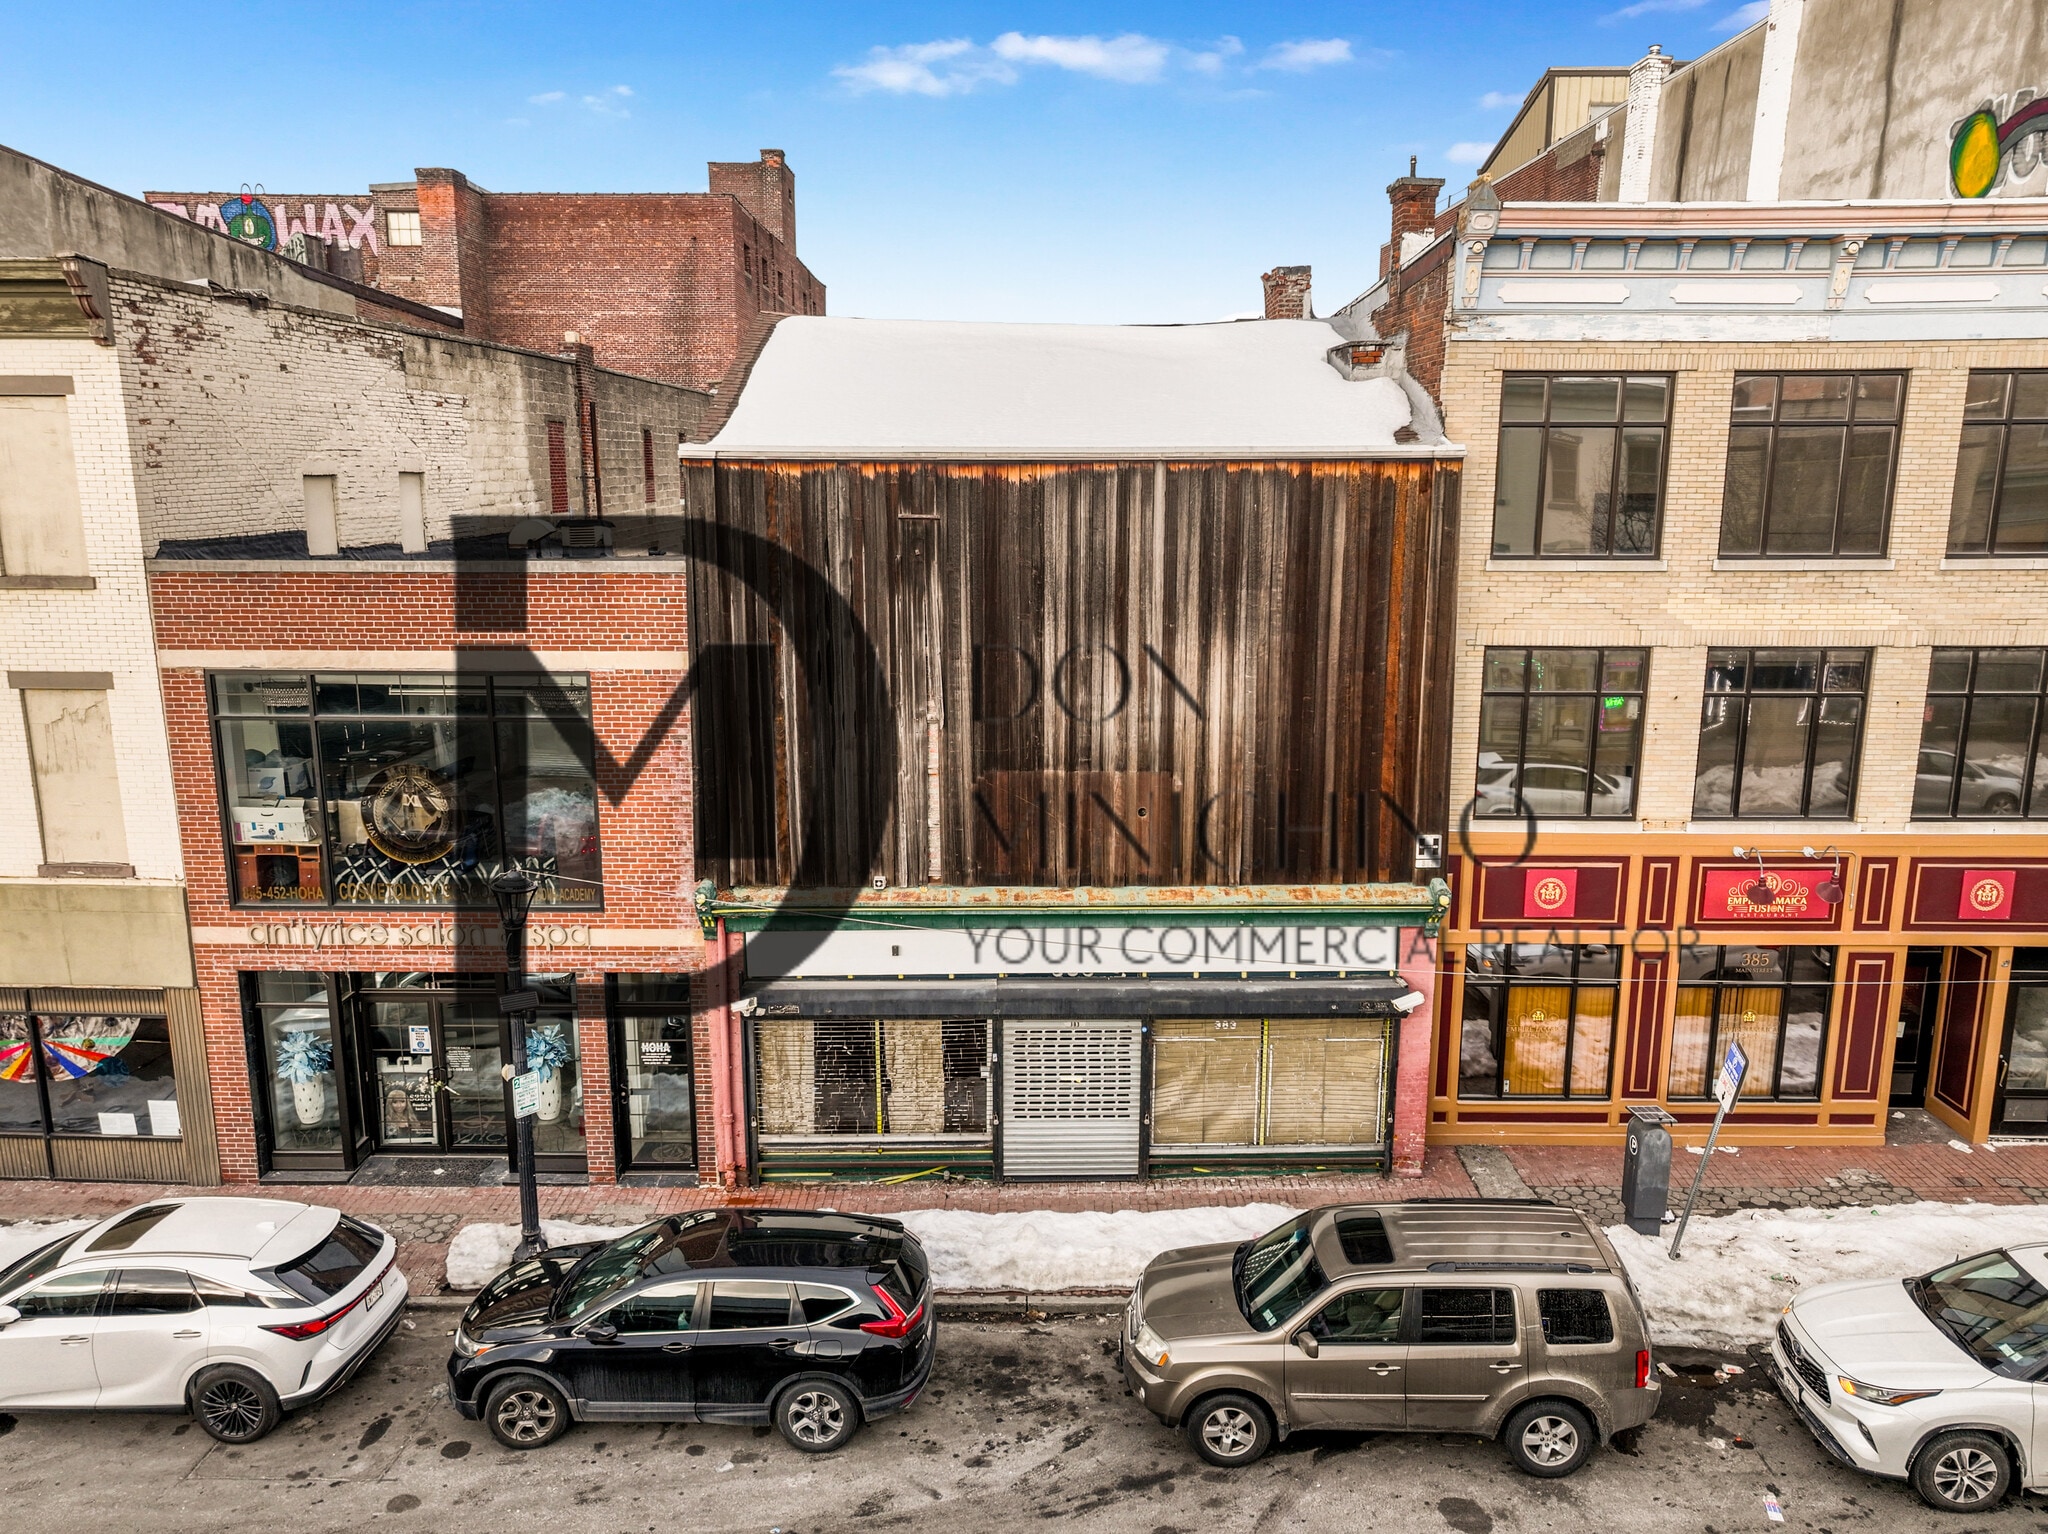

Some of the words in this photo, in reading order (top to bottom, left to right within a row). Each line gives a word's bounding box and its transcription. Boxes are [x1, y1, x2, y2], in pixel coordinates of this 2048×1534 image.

[339, 882, 438, 901] COSMETOLOGY
[559, 887, 596, 902] ACADEMY
[1727, 897, 1763, 905] EMPI
[1765, 897, 1807, 905] MAICA
[1748, 905, 1785, 913] FUSION
[399, 919, 486, 948] salon
[531, 923, 591, 951] spa
[1741, 952, 1770, 967] 385
[641, 1042, 671, 1053] HOHA
